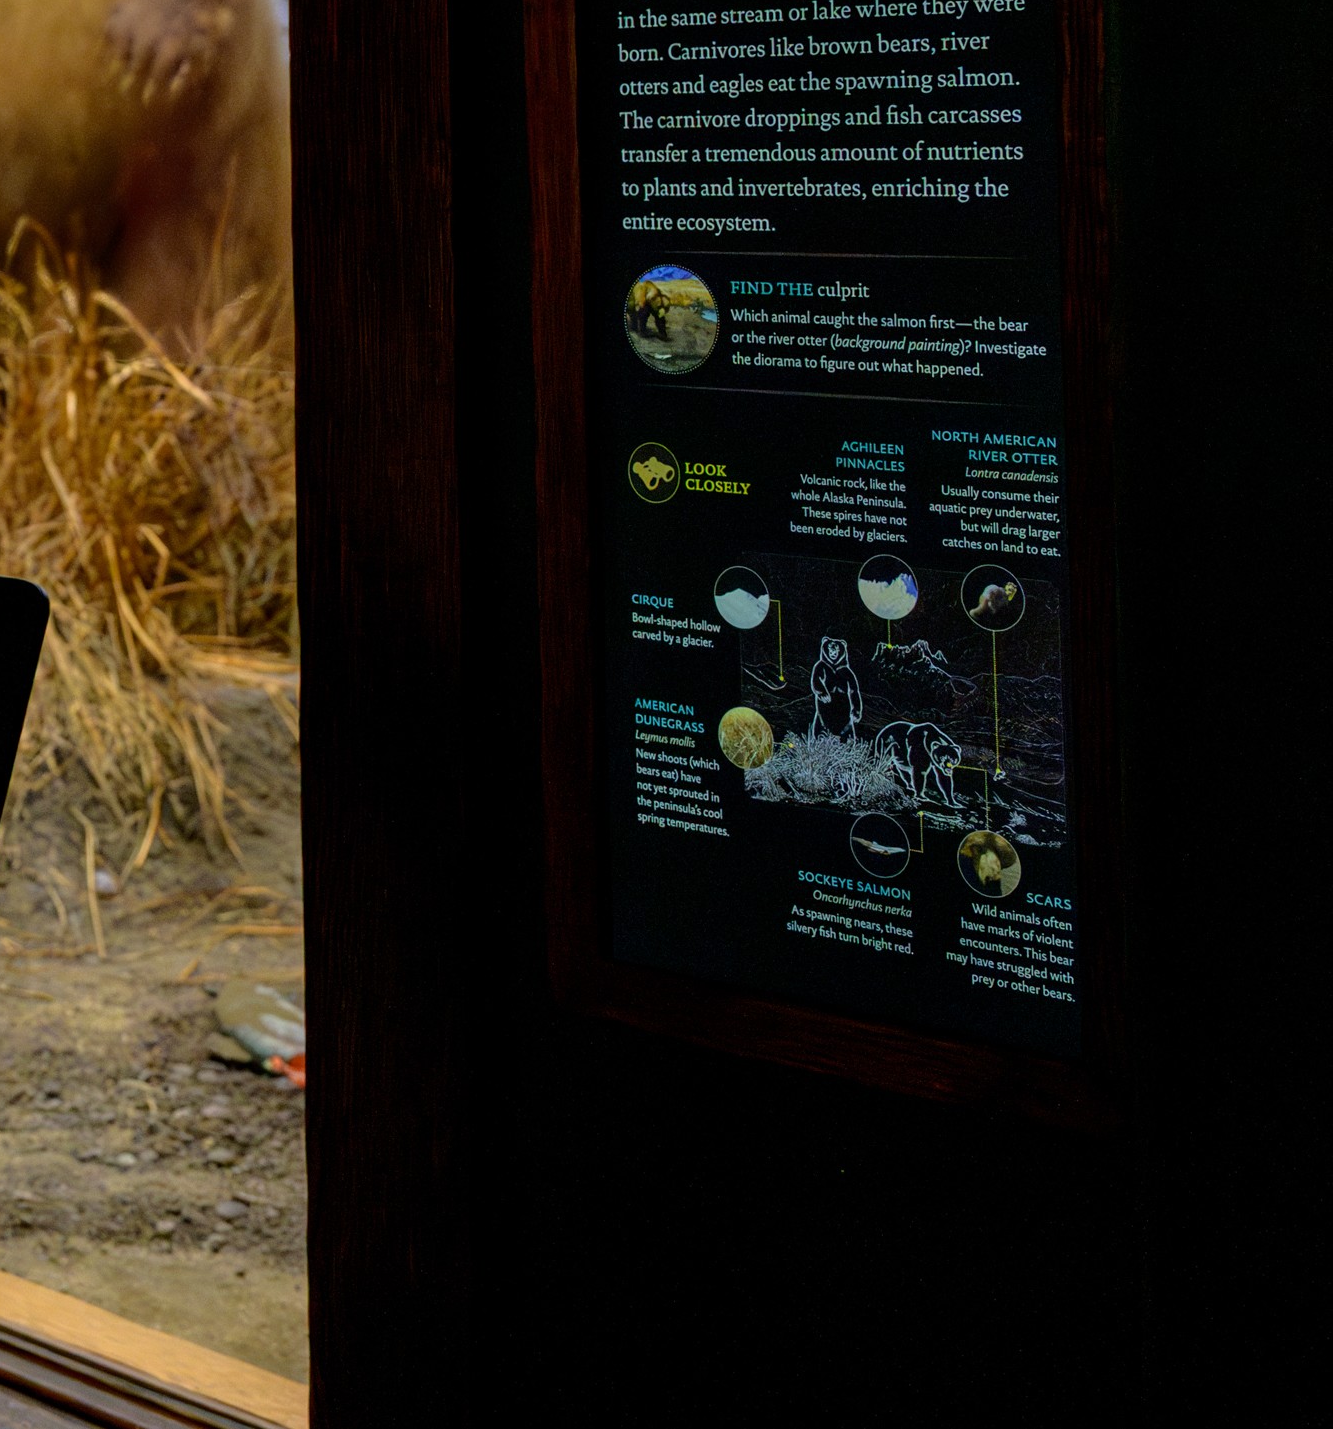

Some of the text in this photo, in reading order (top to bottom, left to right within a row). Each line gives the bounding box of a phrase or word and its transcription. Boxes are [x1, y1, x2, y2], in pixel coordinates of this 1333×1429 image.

[617, 11, 636, 29] in
[638, 8, 668, 29] the
[671, 11, 717, 27] same
[720, 8, 784, 25] stream
[788, 7, 809, 22] or
[617, 31, 991, 63] born. Carnivores like brown bears, river
[619, 66, 1021, 99] otters and eagles eat the spawning salmon.
[618, 103, 1023, 133] The carnivore droppings and fish carcasses
[620, 139, 1024, 163] transfer a tremendous amount of nutrients
[621, 176, 1009, 204] to plants and invertebrates, enriching the
[622, 212, 776, 237] entire ecosystem.
[730, 280, 870, 302] FIND THE culprit
[730, 307, 769, 323] Which
[771, 310, 811, 324] animal
[813, 311, 855, 329] caught
[857, 311, 878, 327] the
[880, 312, 927, 329] salmon
[998, 316, 1029, 332] bear
[731, 330, 1047, 359] or the river otter (background painting)? Investigate
[731, 351, 984, 379] the diorama to figure out what happened.
[841, 440, 904, 456] AGHILEEN
[931, 429, 1057, 449] NORTH AMERICAN
[835, 456, 906, 473] PINNACLES
[968, 449, 1059, 466] RIVER OTTER
[684, 461, 727, 477] LOOK
[684, 478, 751, 495] CLOSELY
[631, 593, 674, 610] CIRQUE
[631, 611, 721, 633] Bowl-shaped hollow
[631, 630, 715, 649] carved by a glacier.
[634, 697, 695, 716] AMERICAN
[635, 713, 705, 734] DUNEGRASS
[797, 870, 911, 901] SOCKEYE SALMON
[884, 905, 913, 918] nerka
[1026, 892, 1072, 911] SCARS
